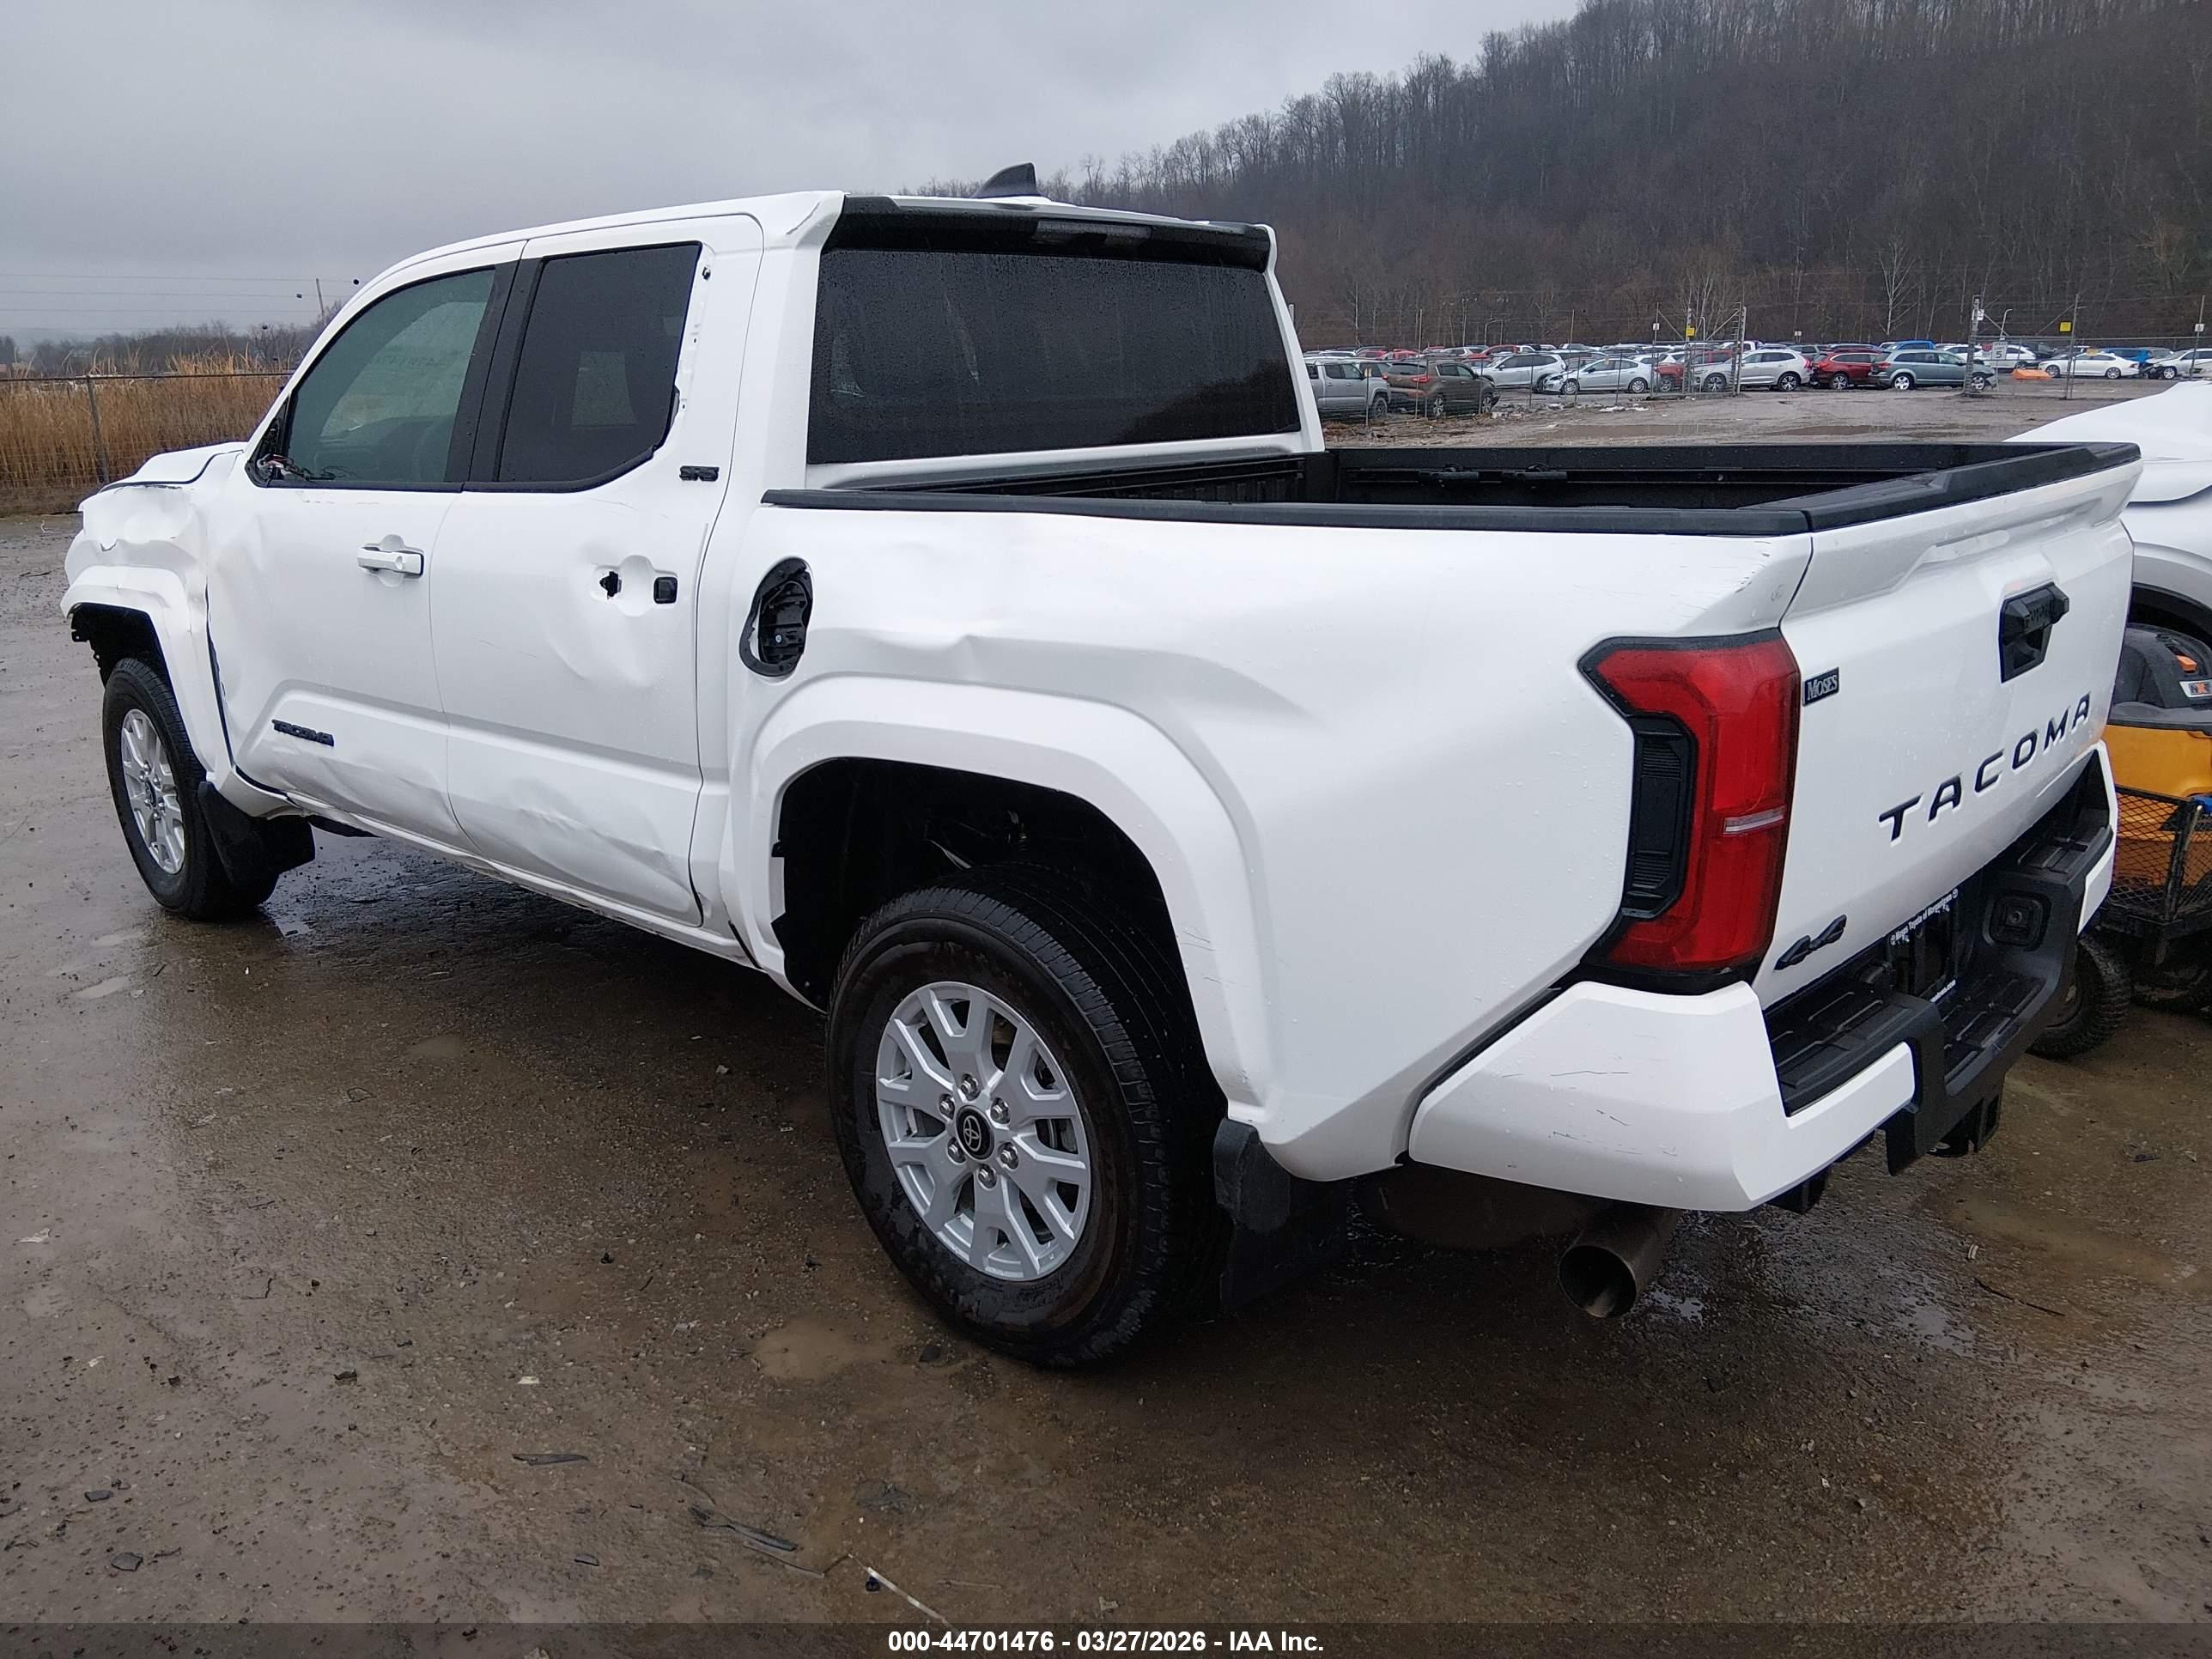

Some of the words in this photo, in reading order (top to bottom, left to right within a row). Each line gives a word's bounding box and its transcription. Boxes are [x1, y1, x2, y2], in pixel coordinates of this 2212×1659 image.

[1996, 350, 2002, 359] 5
[271, 719, 335, 747] TACOMA
[1878, 692, 2091, 842] TACOMA
